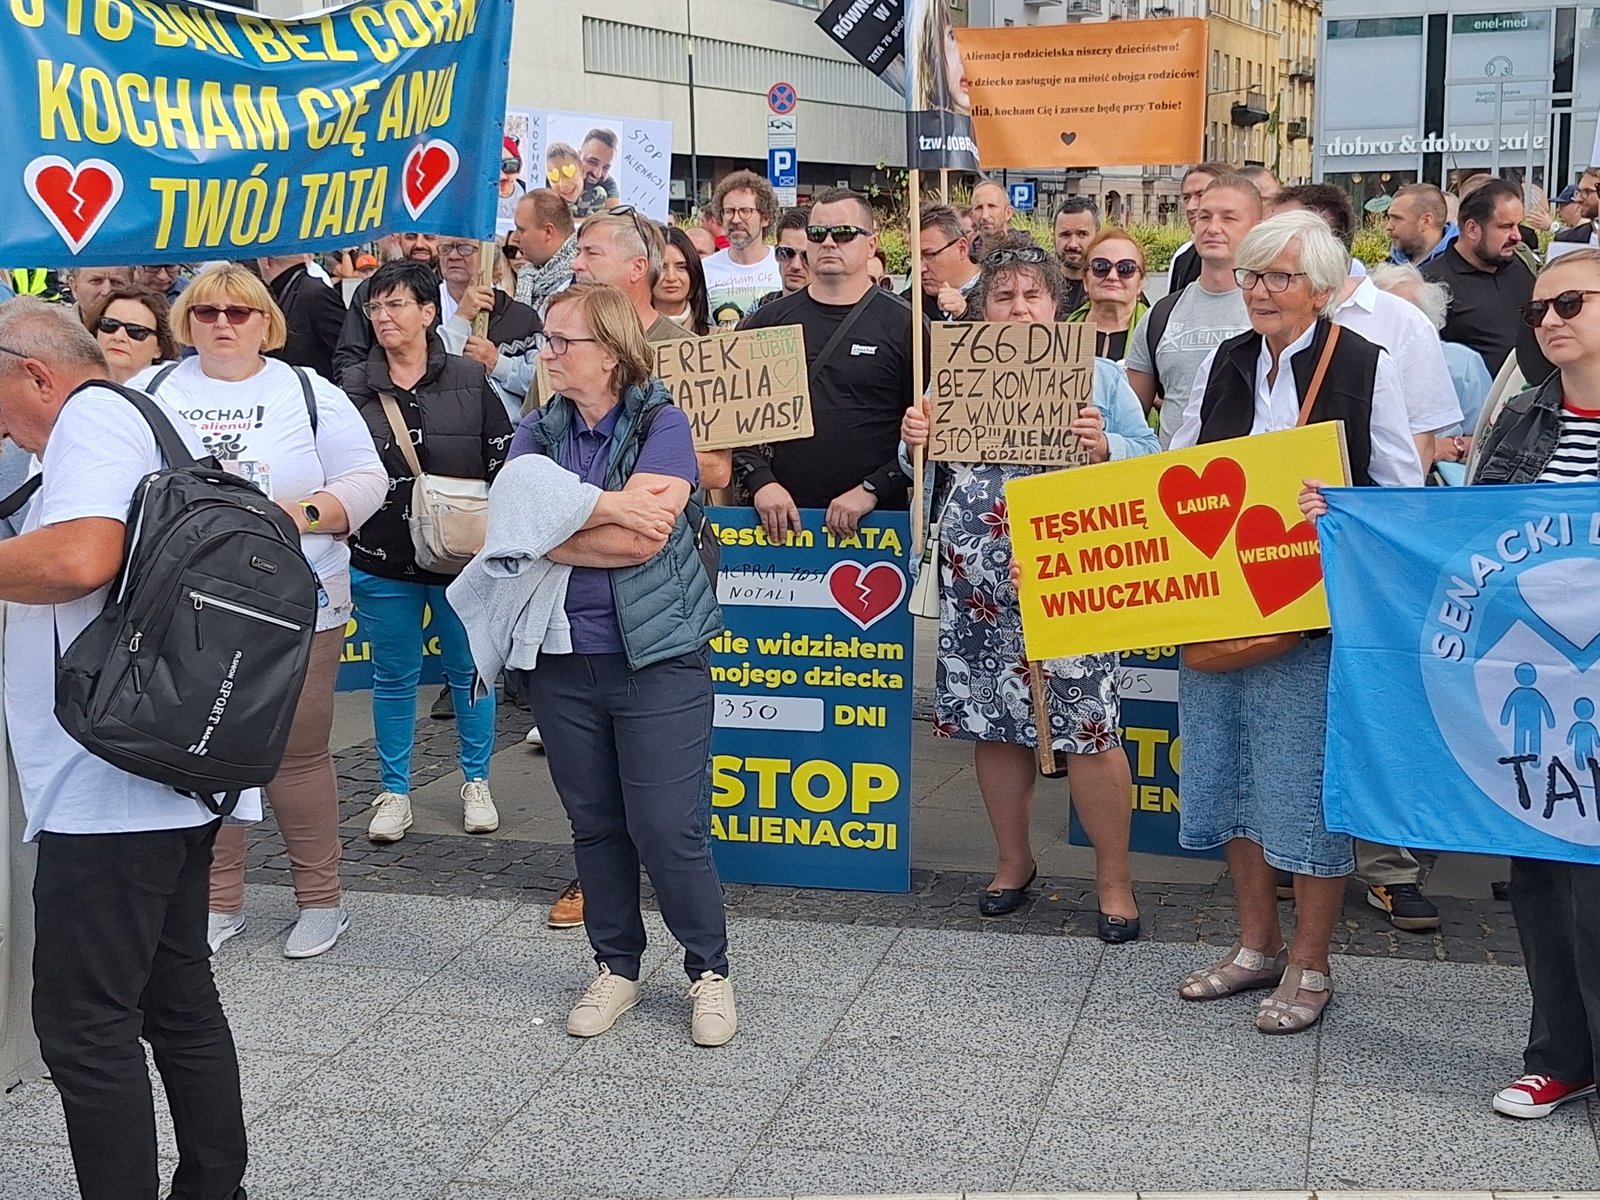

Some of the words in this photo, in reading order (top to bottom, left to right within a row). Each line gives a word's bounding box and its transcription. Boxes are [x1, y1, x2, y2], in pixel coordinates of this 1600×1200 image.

[131, 0, 244, 59] DNI
[236, 15, 358, 62] BEZ
[1474, 16, 1528, 30] enel-med
[867, 45, 885, 63] TATA
[881, 35, 892, 46] 76
[964, 50, 1011, 62] Alienacja
[1013, 48, 1074, 60] rodzicielska
[1076, 47, 1113, 58] niszczy
[1115, 43, 1180, 55] dzieciństwo!
[974, 76, 1013, 87] dziecko
[1015, 75, 1062, 88] zasługuje
[1064, 76, 1076, 84] na
[1078, 73, 1110, 84] miłość
[1111, 72, 1146, 84] obojga
[1148, 69, 1200, 80] rodziców!
[37, 59, 290, 150] KOCHAM
[298, 79, 381, 157] CIĘ
[994, 104, 1035, 116] kocham
[1037, 105, 1052, 116] Cię
[1054, 105, 1058, 114] i
[1060, 104, 1096, 114] zawsze
[1097, 103, 1121, 114] będę
[1123, 103, 1145, 114] przy
[1148, 101, 1182, 111] Tobie!
[530, 116, 541, 184] KOCHAM
[628, 129, 663, 160] STOP
[1327, 136, 1393, 156] dobro
[1399, 134, 1418, 154] &
[1420, 132, 1490, 153] dobro
[624, 154, 667, 191] ALIENACJI
[774, 151, 791, 177] P
[150, 163, 290, 250] TWÓJ
[298, 166, 388, 240] TATA
[1014, 186, 1029, 207] P
[942, 323, 1017, 363] 766
[1024, 323, 1083, 364] DNI
[937, 368, 987, 398] BEZ
[992, 366, 1093, 401] KONTAKTU
[200, 420, 252, 431] alienuj
[736, 395, 804, 435] WAS!
[936, 400, 955, 424] Z
[1030, 499, 1149, 543] TĘSKNIĘ
[1176, 494, 1231, 515] LAURA
[1036, 553, 1073, 580] ZA
[1079, 536, 1170, 573] MOIMI
[1041, 571, 1220, 618] WNUCZKAMI
[1433, 512, 1573, 662] SENACKI
[757, 632, 904, 660] widziałem
[804, 666, 904, 689] dziecka
[208, 680, 234, 725] SPORT
[834, 704, 886, 727] DNI
[711, 754, 900, 814] STOP
[710, 814, 897, 850] ALIENACJI
